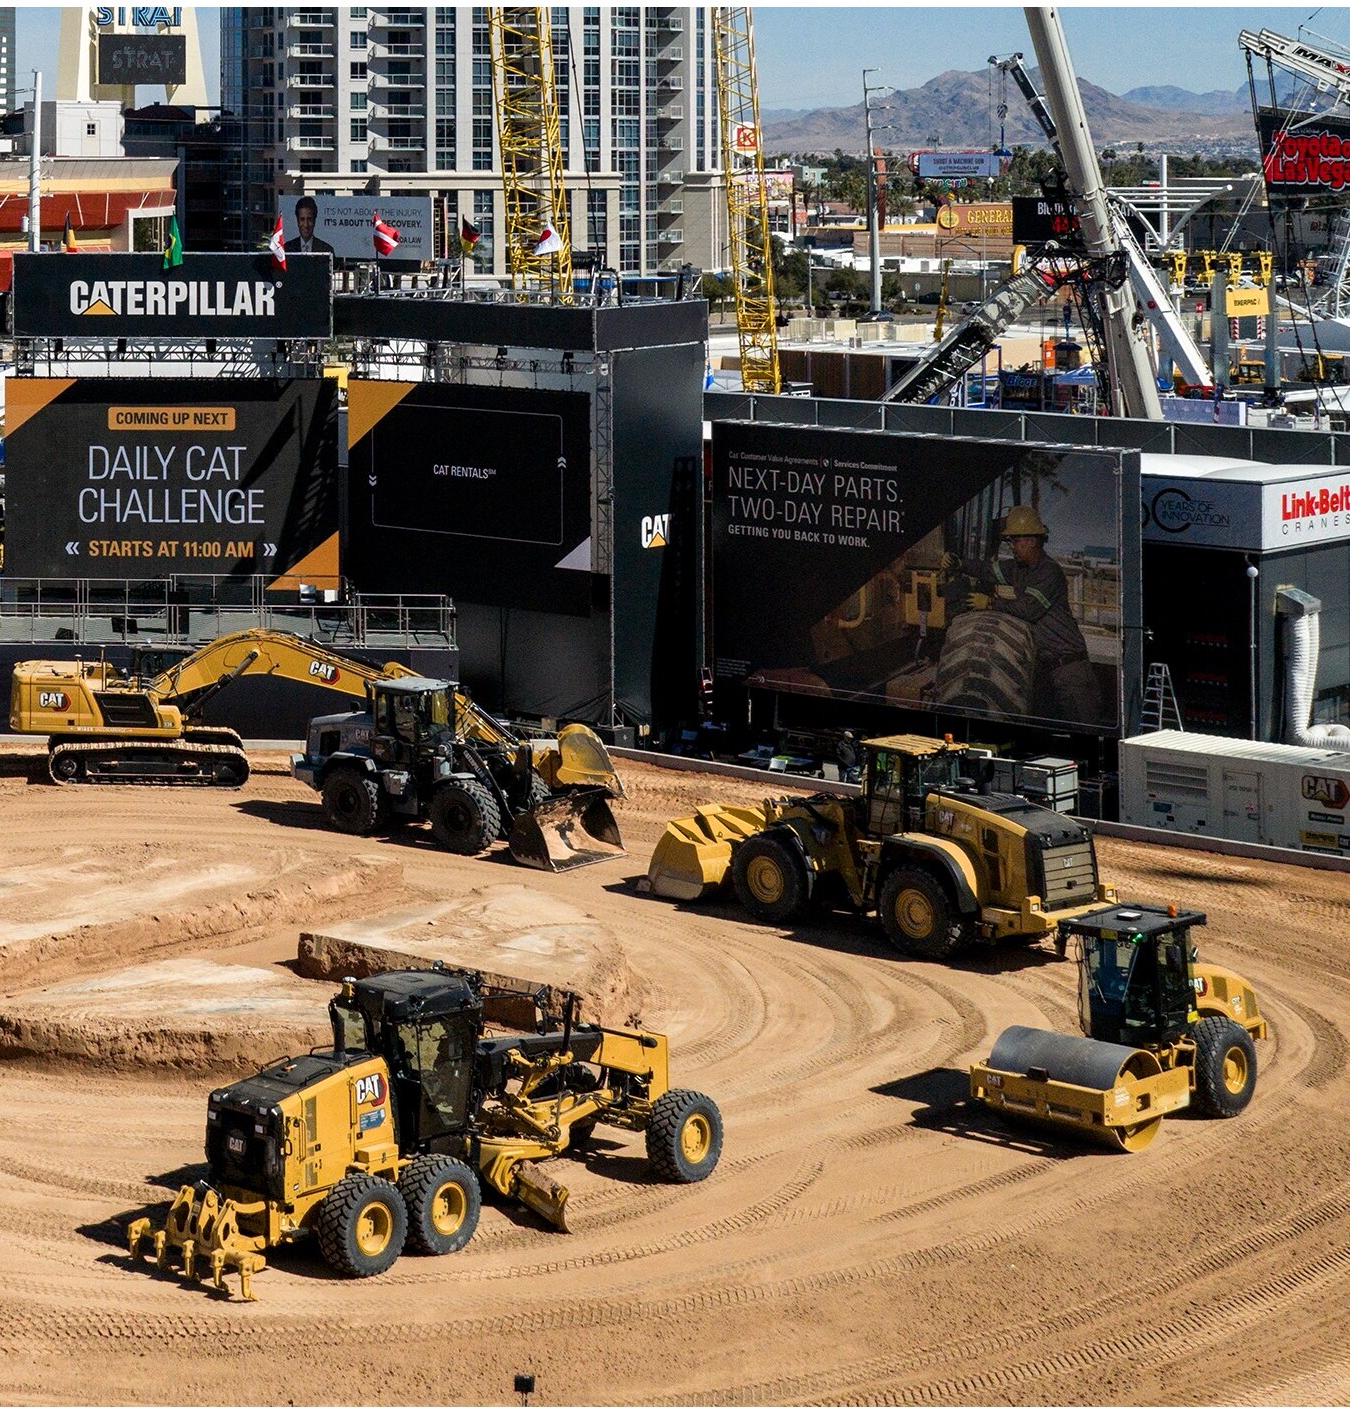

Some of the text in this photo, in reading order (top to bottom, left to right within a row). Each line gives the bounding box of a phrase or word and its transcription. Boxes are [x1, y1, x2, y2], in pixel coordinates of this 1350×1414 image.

[1295, 47, 1350, 77] MAX
[1272, 129, 1341, 160] Toyota
[324, 208, 336, 216] IT'S
[338, 208, 352, 216] NOT
[339, 219, 363, 227] ABOUT
[116, 412, 228, 425] COMING UP NEXT
[88, 445, 247, 481] DAILY CAT
[433, 464, 449, 475] CAT
[740, 452, 767, 461] Customer
[768, 454, 783, 463] Value
[784, 455, 818, 467] Agreements
[834, 459, 859, 469] Services
[860, 462, 897, 472] Commitment
[728, 466, 904, 503] NEXT-DAY PARTS.
[78, 487, 265, 524] CHALLENGE
[728, 495, 823, 525] TWO-DAY
[1161, 500, 1196, 512] YEARS
[1199, 502, 1214, 512] OF
[1281, 485, 1350, 521] Link-Belt
[1162, 511, 1230, 524] INNOVATION
[641, 513, 672, 549] CAT
[728, 524, 871, 548] GETTING YOU BACK TO WORK.
[89, 540, 254, 557] STARTS AT 11:00 AM
[309, 660, 336, 680] CAT
[39, 692, 64, 708] CAT
[355, 730, 369, 741] CAT
[1302, 775, 1339, 801] CAT
[938, 811, 954, 825] CAT
[356, 1076, 380, 1104] CAT
[986, 1074, 1001, 1086] CAT
[229, 1138, 243, 1153] CAT
